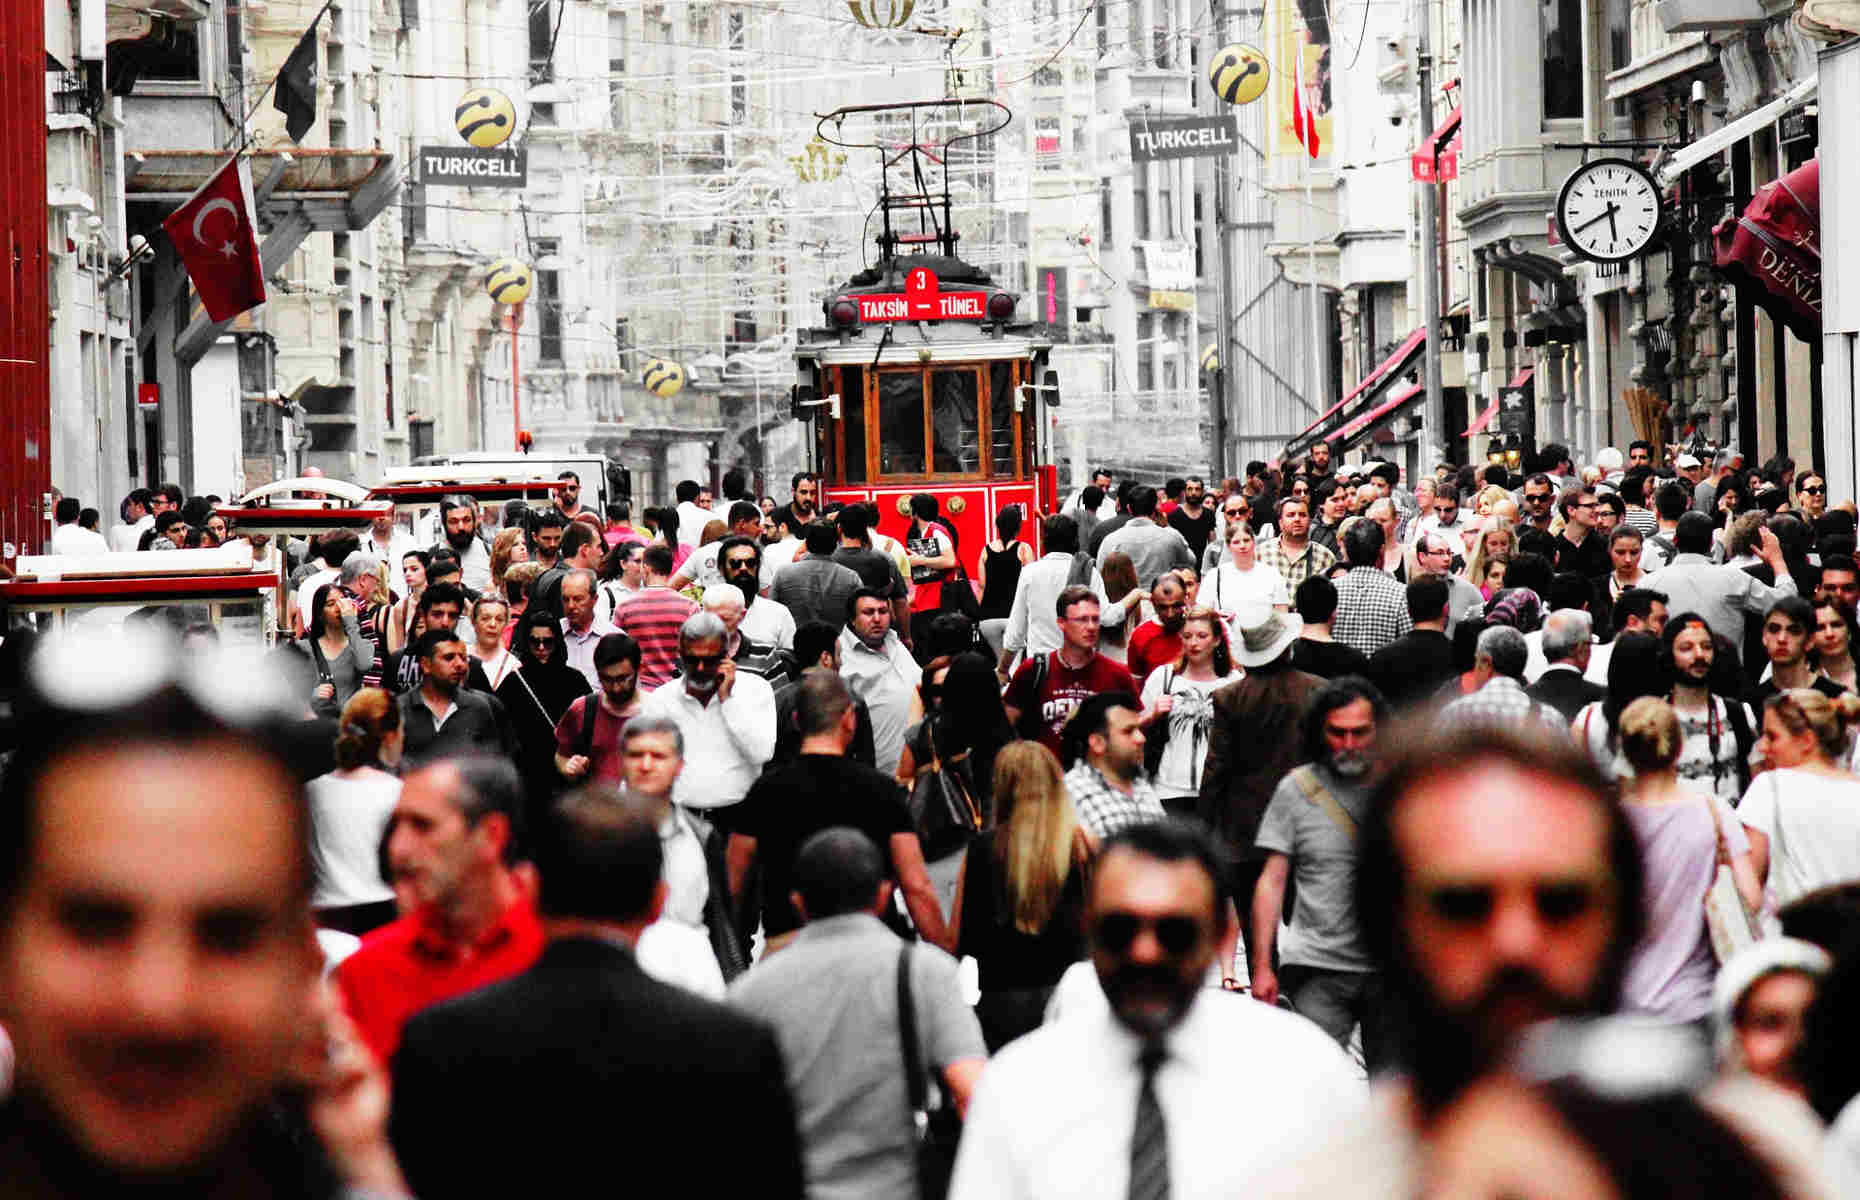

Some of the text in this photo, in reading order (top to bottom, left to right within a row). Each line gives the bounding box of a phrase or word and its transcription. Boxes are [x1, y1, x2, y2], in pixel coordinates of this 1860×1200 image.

[1135, 126, 1233, 151] TURKCELL
[425, 155, 522, 178] TURKCELL
[1594, 188, 1628, 198] ZENITH
[916, 271, 926, 290] 3
[939, 296, 983, 317] TÜNEL
